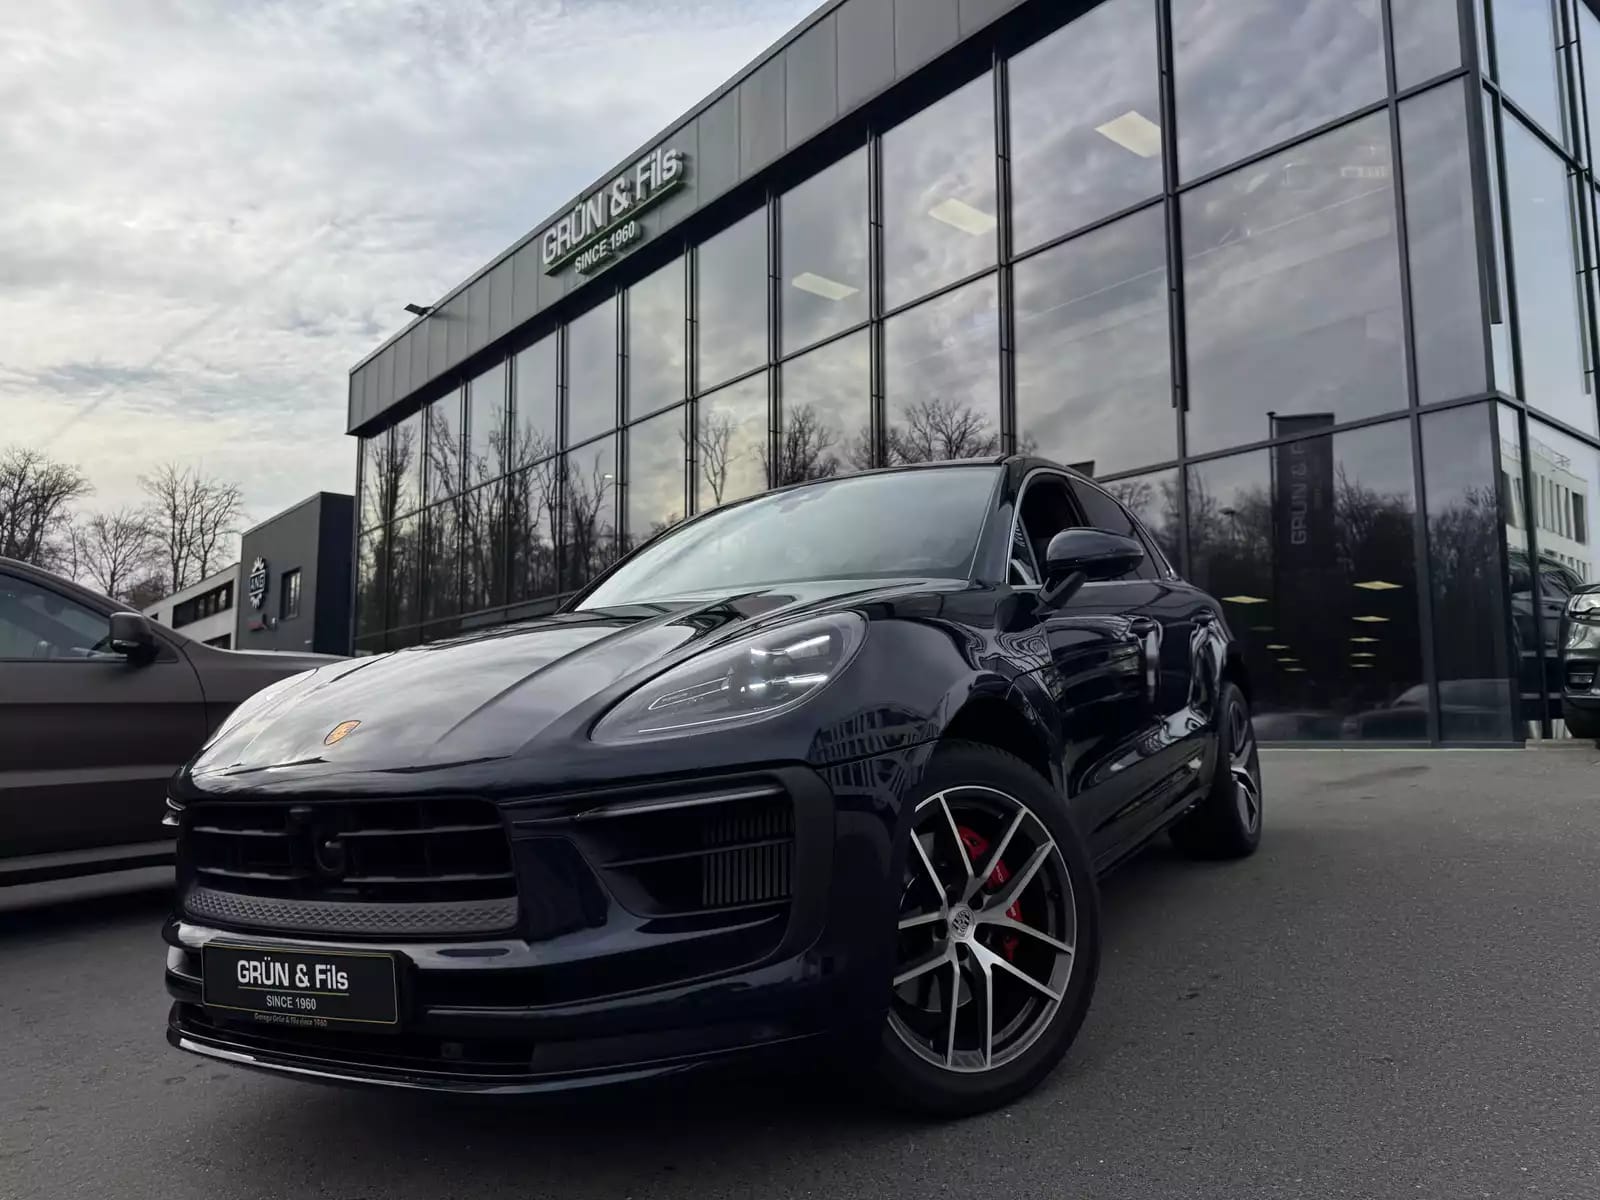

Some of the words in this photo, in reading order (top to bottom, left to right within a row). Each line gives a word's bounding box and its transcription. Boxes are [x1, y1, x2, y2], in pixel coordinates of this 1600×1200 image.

[542, 192, 602, 264] GRÜN
[610, 177, 629, 216] &
[636, 148, 678, 200] Fils
[575, 239, 607, 274] SINCE
[610, 220, 635, 250] 1960
[237, 956, 289, 986] GRÜN
[295, 964, 310, 987] &
[315, 964, 349, 990] Fils
[266, 995, 293, 1008] SINCE
[295, 998, 317, 1010] 1960
